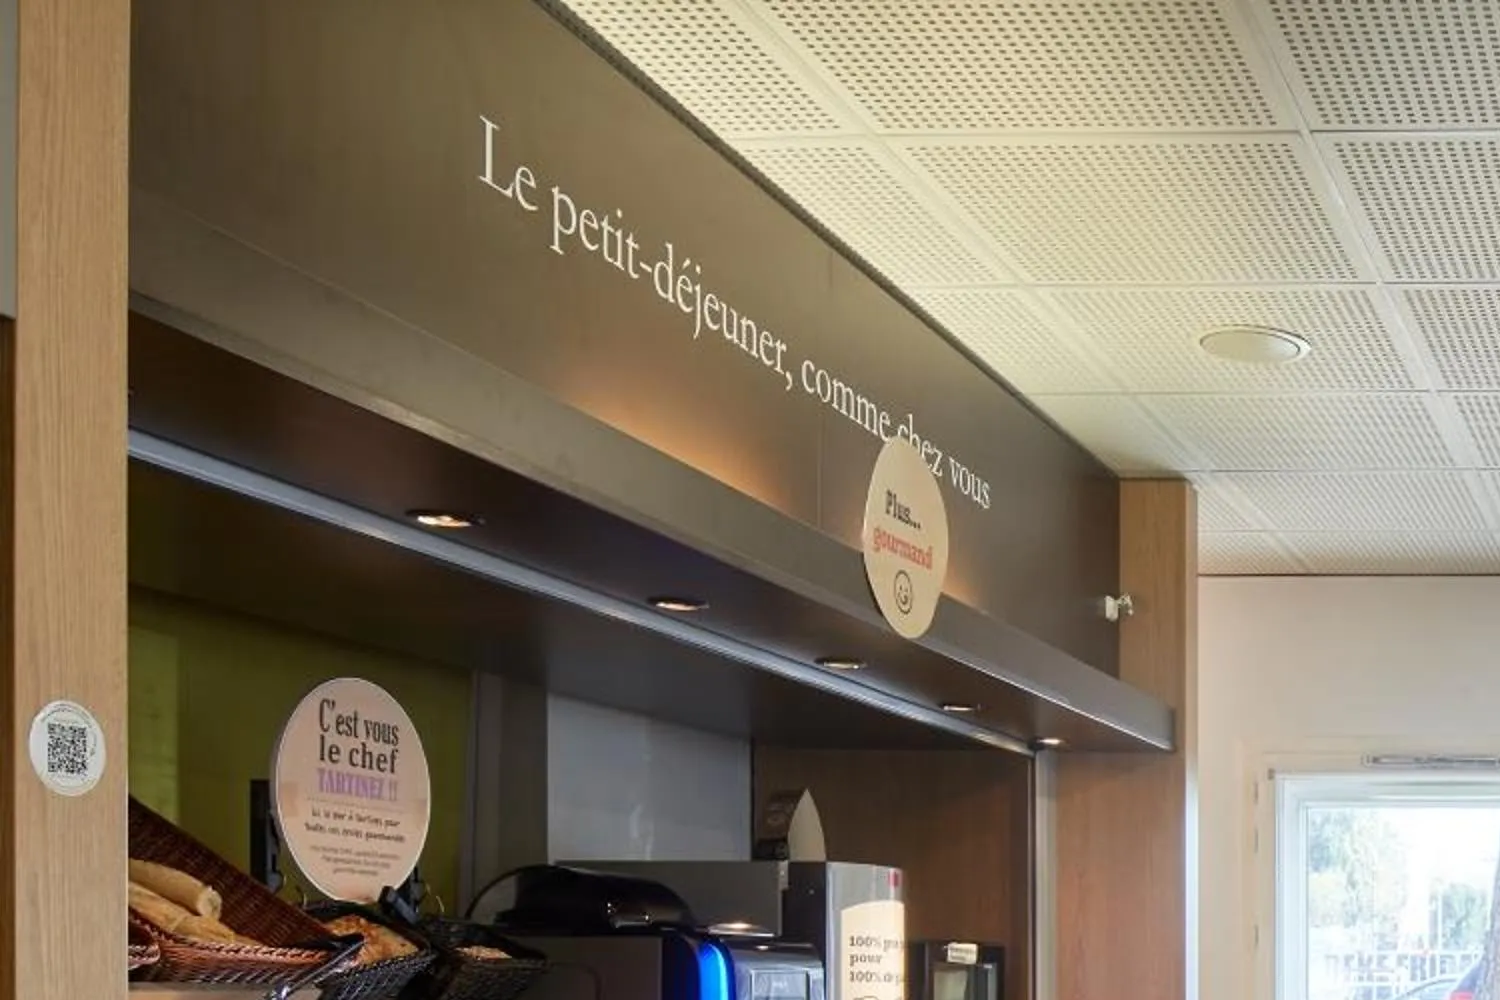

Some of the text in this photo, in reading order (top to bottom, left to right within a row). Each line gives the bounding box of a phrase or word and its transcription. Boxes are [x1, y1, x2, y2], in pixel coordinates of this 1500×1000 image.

[478, 114, 539, 211] Le
[549, 185, 794, 392] petit-déjeuner,
[801, 359, 892, 442] comme
[948, 456, 991, 509] vous
[873, 527, 933, 571] gourmand
[319, 698, 399, 747] C'est vous
[319, 734, 399, 774] le chef
